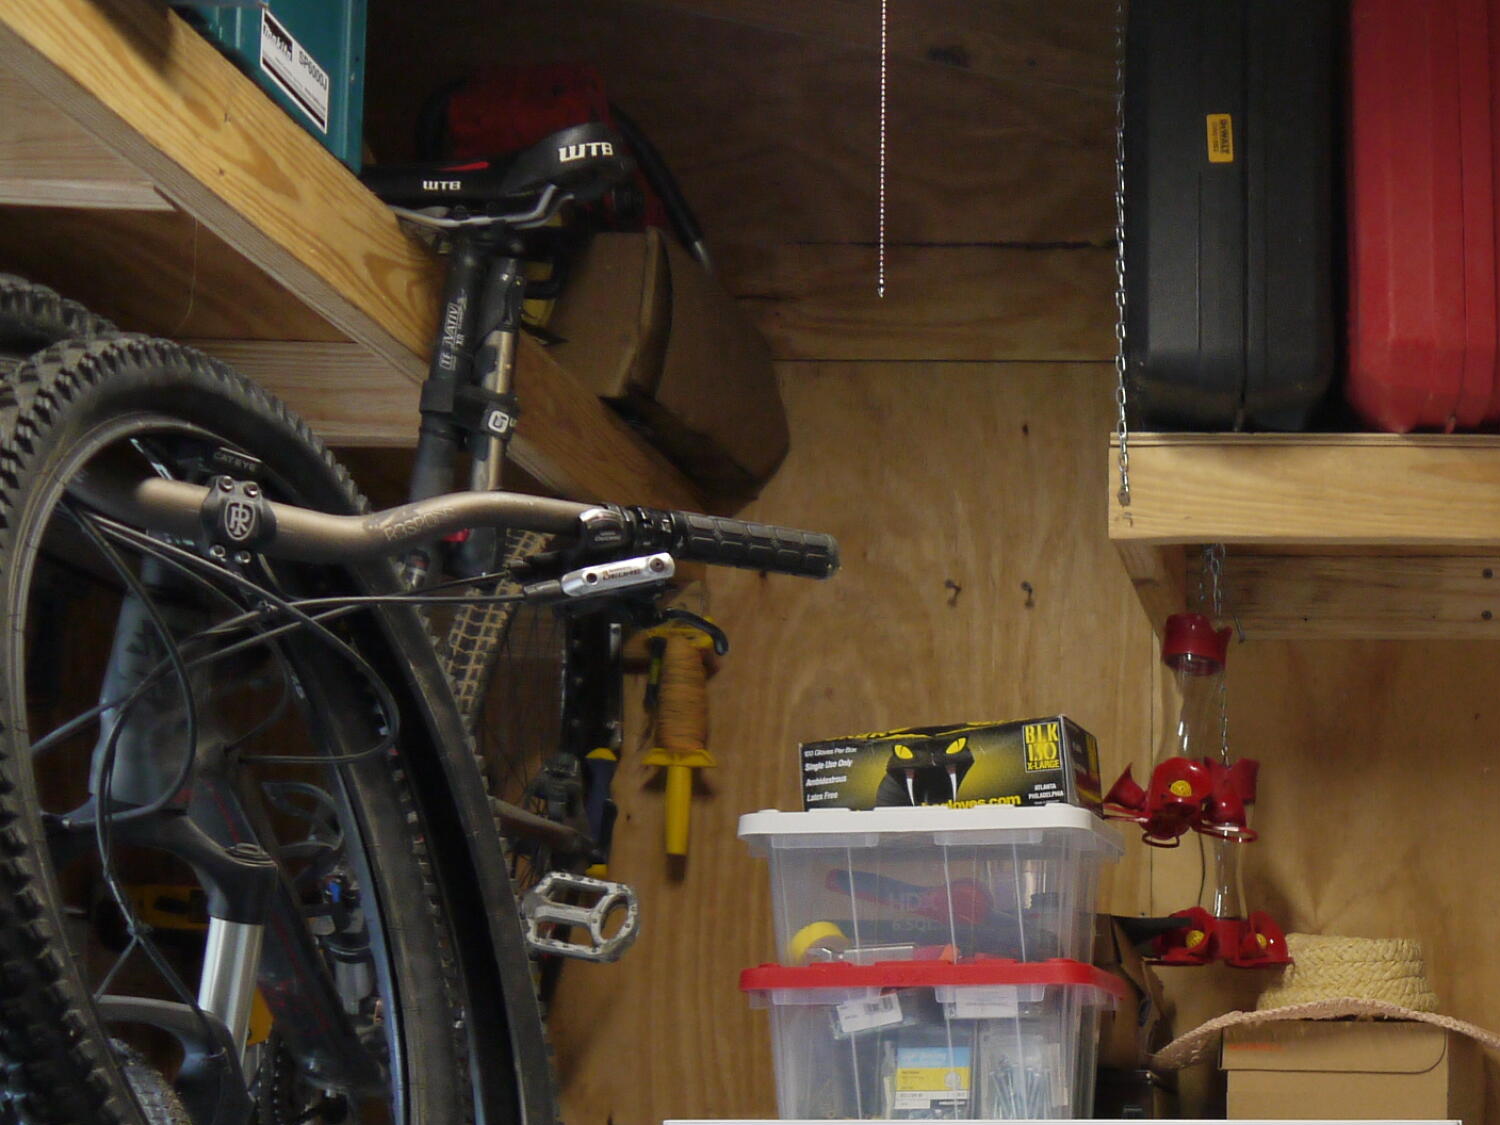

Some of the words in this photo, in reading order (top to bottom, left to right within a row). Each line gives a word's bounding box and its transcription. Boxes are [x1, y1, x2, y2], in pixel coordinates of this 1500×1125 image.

[558, 141, 614, 162] WTB
[422, 180, 462, 191] WTB
[1025, 723, 1059, 745] BLK
[804, 763, 824, 772] Single
[838, 758, 853, 769] Only
[1027, 759, 1061, 770] X-LARGE
[806, 792, 823, 802] Latex
[823, 791, 839, 800] Free
[1028, 790, 1064, 800] PHILADELPHIA
